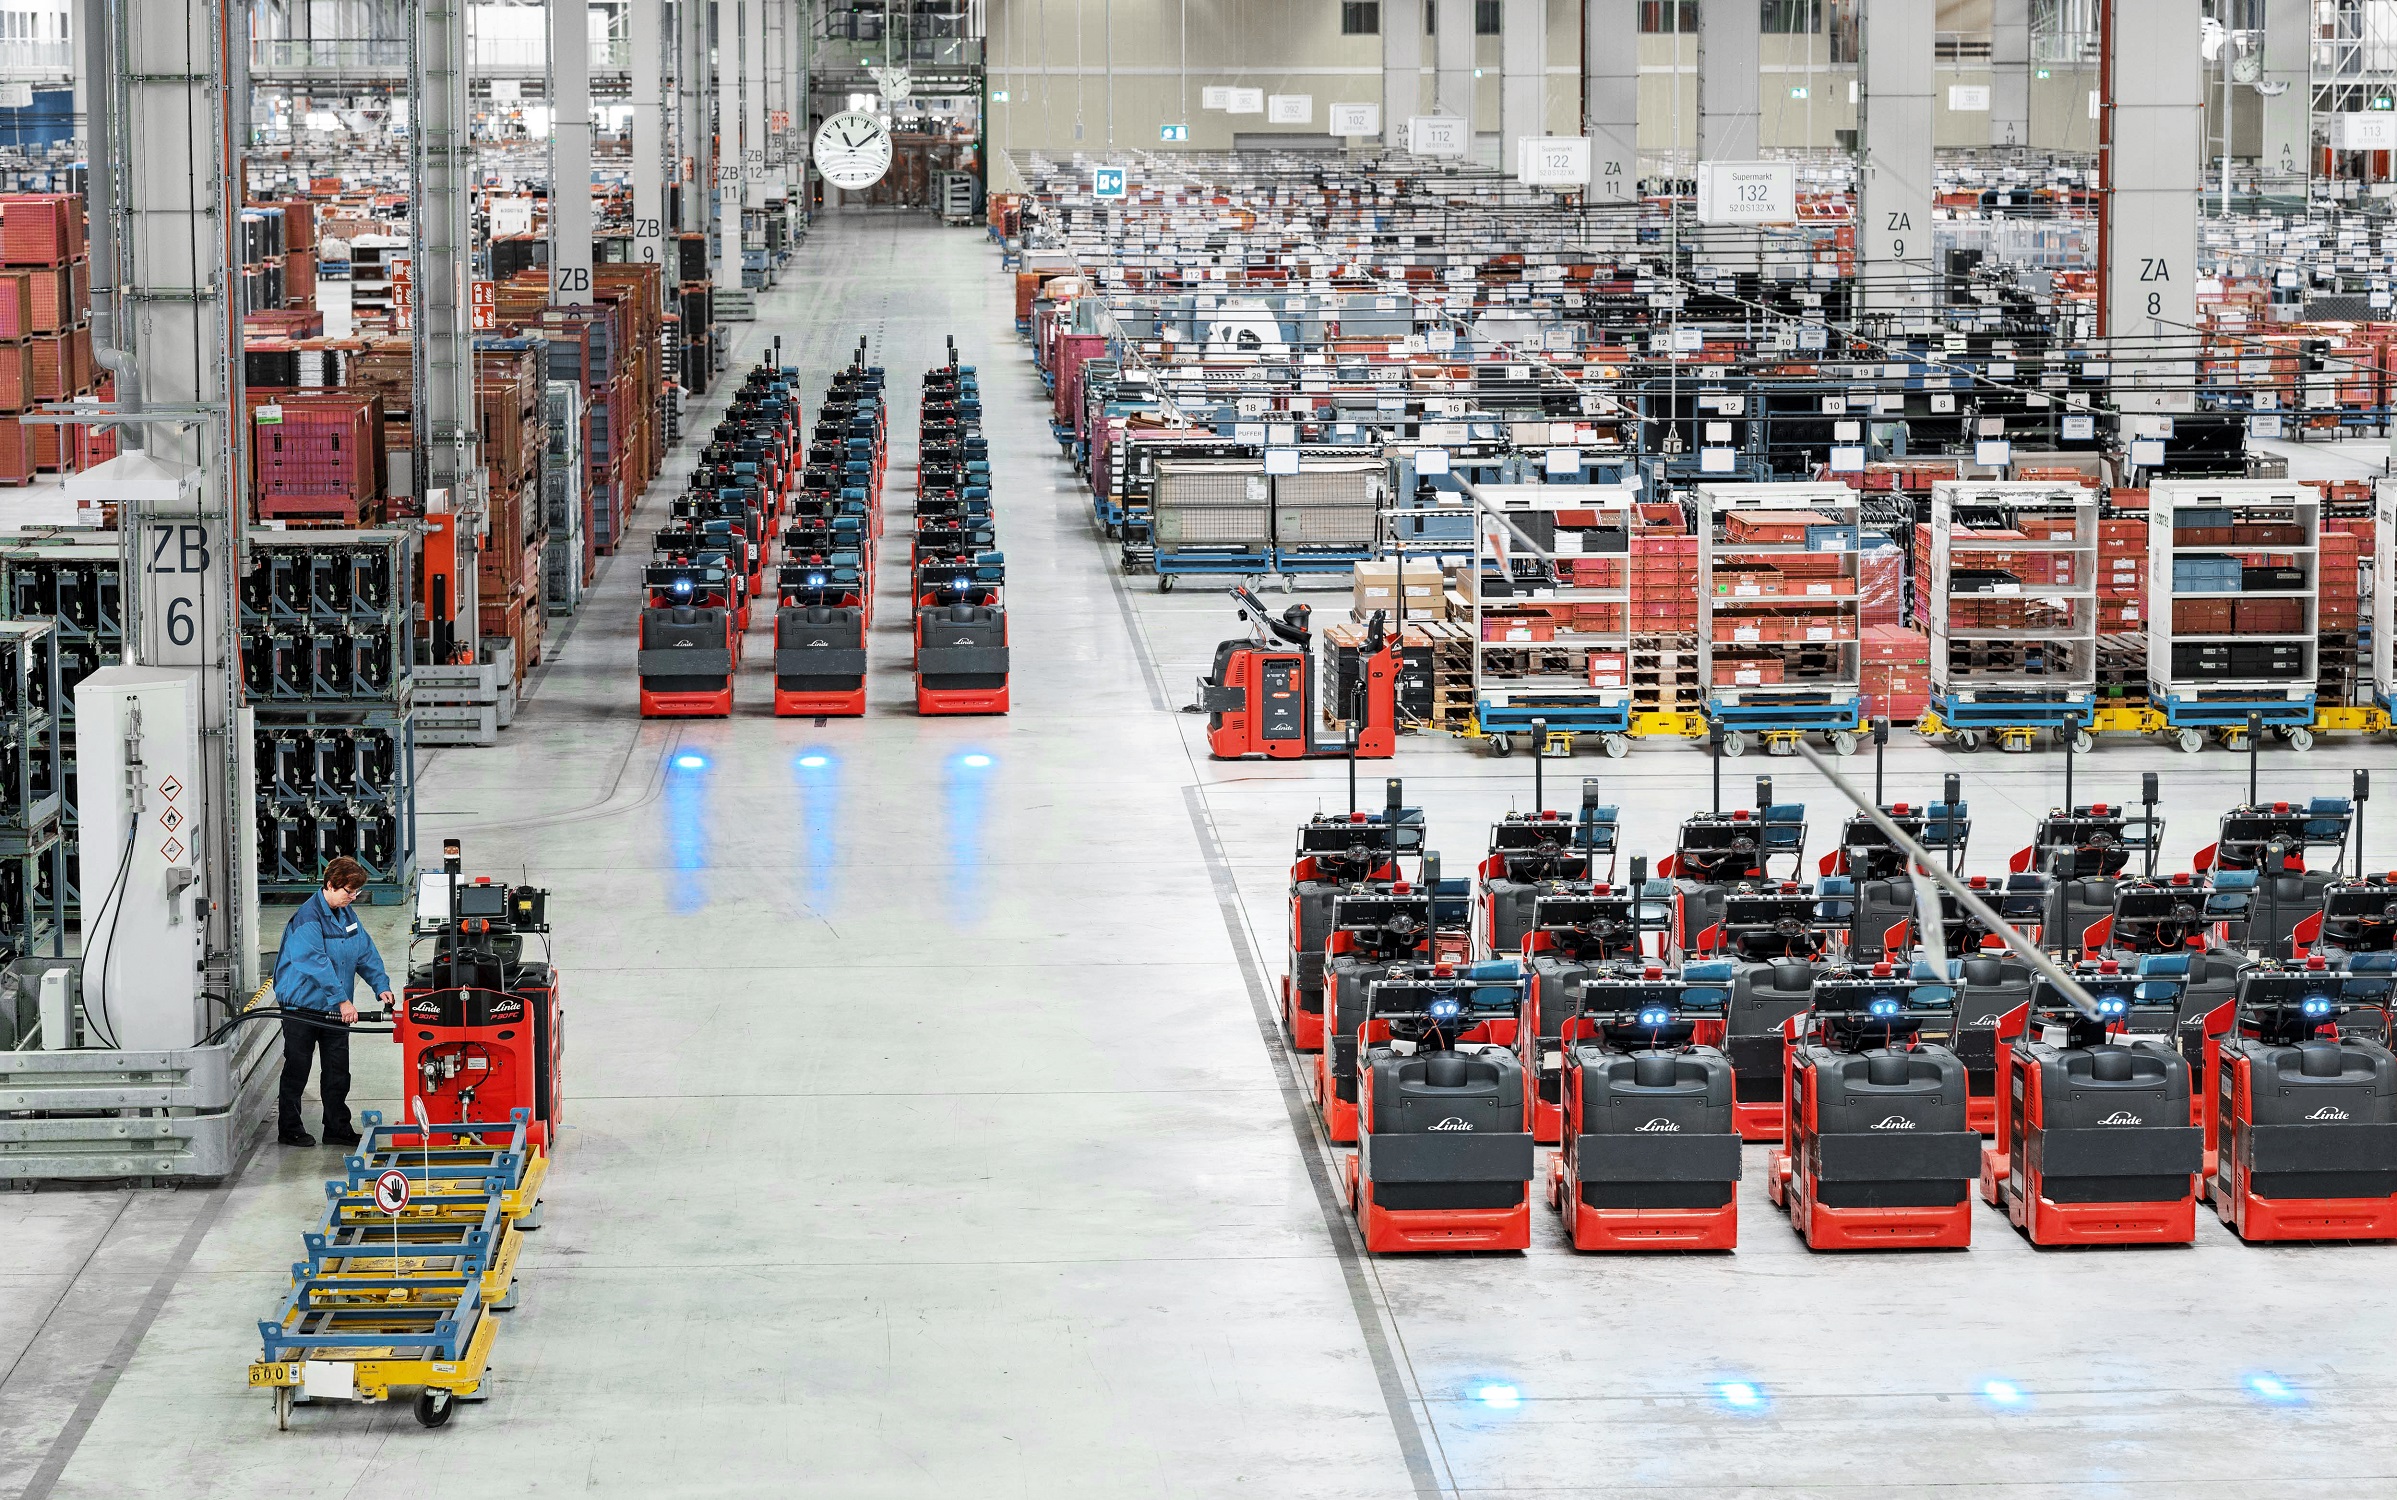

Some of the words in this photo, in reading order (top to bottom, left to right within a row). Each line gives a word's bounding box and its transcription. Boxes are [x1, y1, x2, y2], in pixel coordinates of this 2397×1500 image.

[1349, 116, 1364, 125] 102
[2007, 122, 2014, 132] A
[1431, 131, 1449, 142] 112
[2362, 126, 2381, 137] 113
[1541, 145, 1573, 153] Supermarkt
[2283, 143, 2291, 155] A
[747, 150, 763, 162] ZB
[1546, 155, 1569, 168] 122
[1604, 161, 1622, 176] ZA
[2280, 159, 2293, 172] 12
[721, 166, 739, 180] ZB
[750, 167, 763, 178] 12
[1732, 172, 1773, 182] Supermarkt
[723, 186, 737, 199] 11
[1605, 181, 1620, 194] 11
[1737, 184, 1768, 201] 132
[1729, 204, 1738, 212] 52
[1746, 204, 1765, 212] S132
[1766, 204, 1776, 212] XX
[1887, 212, 1911, 231] ZA
[636, 219, 660, 238] ZB
[643, 246, 654, 264] 9
[1893, 239, 1904, 258] 9
[2140, 258, 2170, 282] ZA
[559, 267, 589, 291] ZB
[2147, 292, 2161, 315] 8
[1410, 340, 1419, 348] 16
[1829, 402, 1840, 410] 10
[1940, 400, 1946, 408] 8
[2155, 398, 2161, 406] 4
[2262, 397, 2268, 405] 2
[1245, 404, 1256, 412] 18
[1448, 404, 1459, 412] 16
[147, 525, 211, 573] ZB
[166, 596, 195, 646] 6
[806, 639, 829, 647] Linde
[1271, 723, 1293, 731] Linde
[411, 1000, 441, 1013] Linde
[489, 999, 521, 1013] Linde
[1969, 1014, 2000, 1026] Lin
[2097, 1111, 2142, 1126] Linde
[2304, 1106, 2349, 1121] Linde
[1427, 1116, 1474, 1132] Linde
[1634, 1117, 1680, 1132] Linde
[1870, 1115, 1916, 1130] Linde
